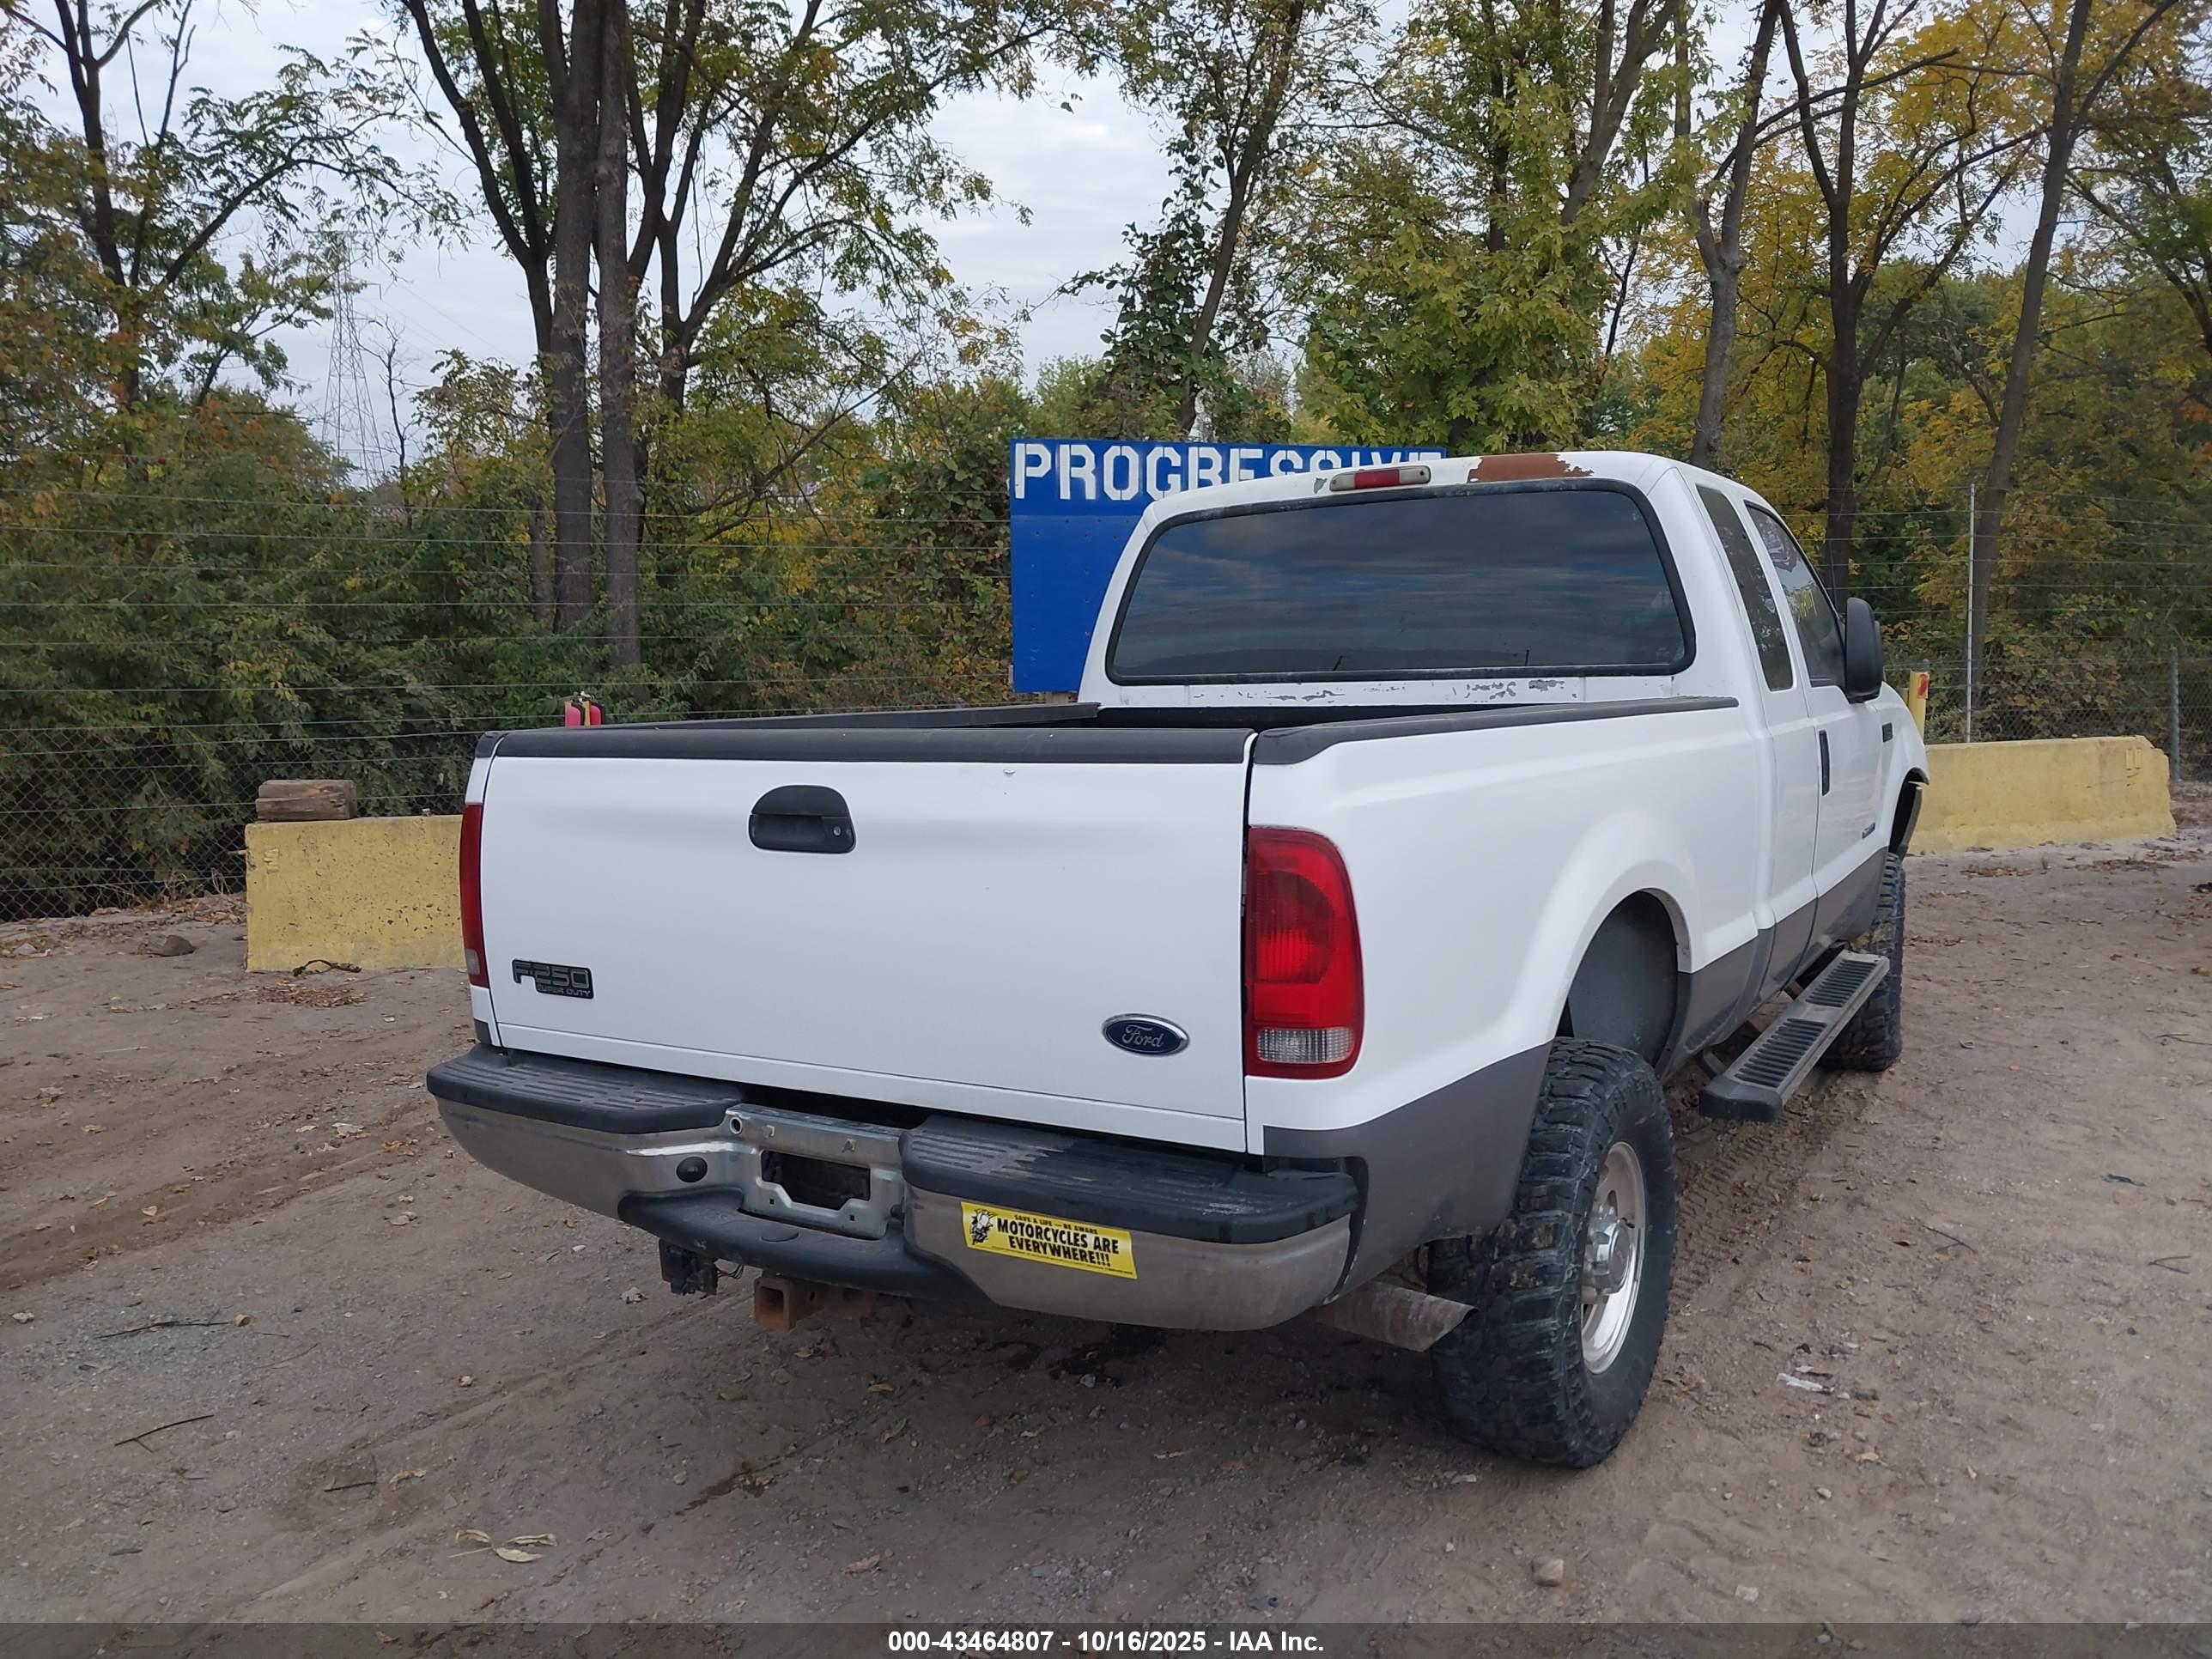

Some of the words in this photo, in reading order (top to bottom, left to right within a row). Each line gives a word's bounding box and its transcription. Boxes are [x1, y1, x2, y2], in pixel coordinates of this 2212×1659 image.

[1015, 443, 1441, 500] PROGRES
[537, 983, 564, 994] SUPER
[566, 988, 592, 997] DUTY
[1121, 1024, 1164, 1048] Ford
[997, 1218, 1088, 1249] MOTORCYCLES
[1093, 1237, 1119, 1255] ARE
[1074, 1224, 1098, 1235] AWARE
[1008, 1235, 1111, 1267] EVERYWHERE!!!
